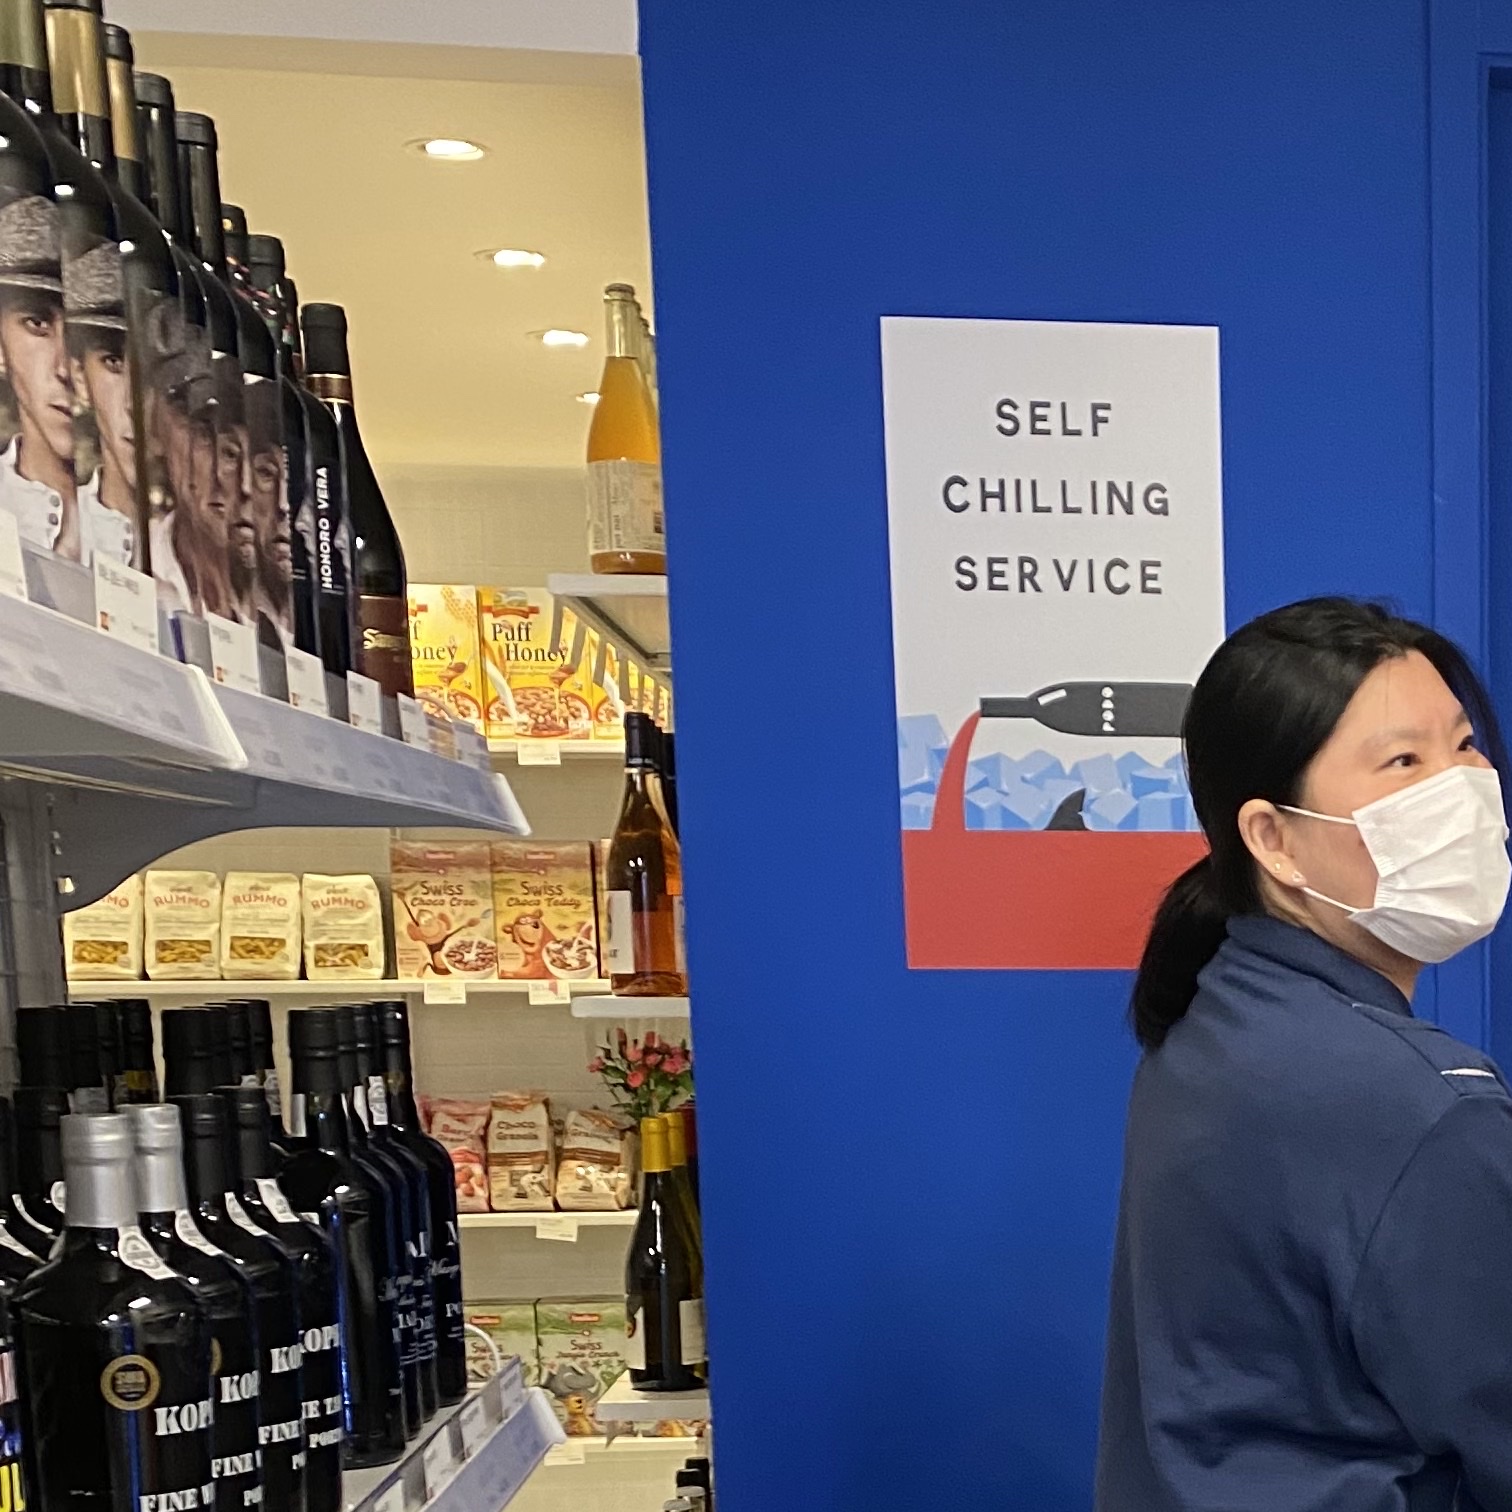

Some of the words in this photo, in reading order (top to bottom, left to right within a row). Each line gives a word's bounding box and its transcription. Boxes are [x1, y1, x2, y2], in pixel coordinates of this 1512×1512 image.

[995, 397, 1112, 438] SELF
[315, 466, 329, 510] VERA
[941, 475, 1171, 517] CHILLING
[318, 517, 333, 589] HONORO
[953, 555, 1164, 596] SERVICE
[491, 621, 532, 642] Puff
[505, 642, 569, 665] Honey
[420, 879, 465, 896] Swiss
[520, 880, 564, 897] Swiss
[154, 894, 211, 910] RUMMO
[231, 893, 288, 909] RUMMO
[310, 894, 367, 911] RUMMO
